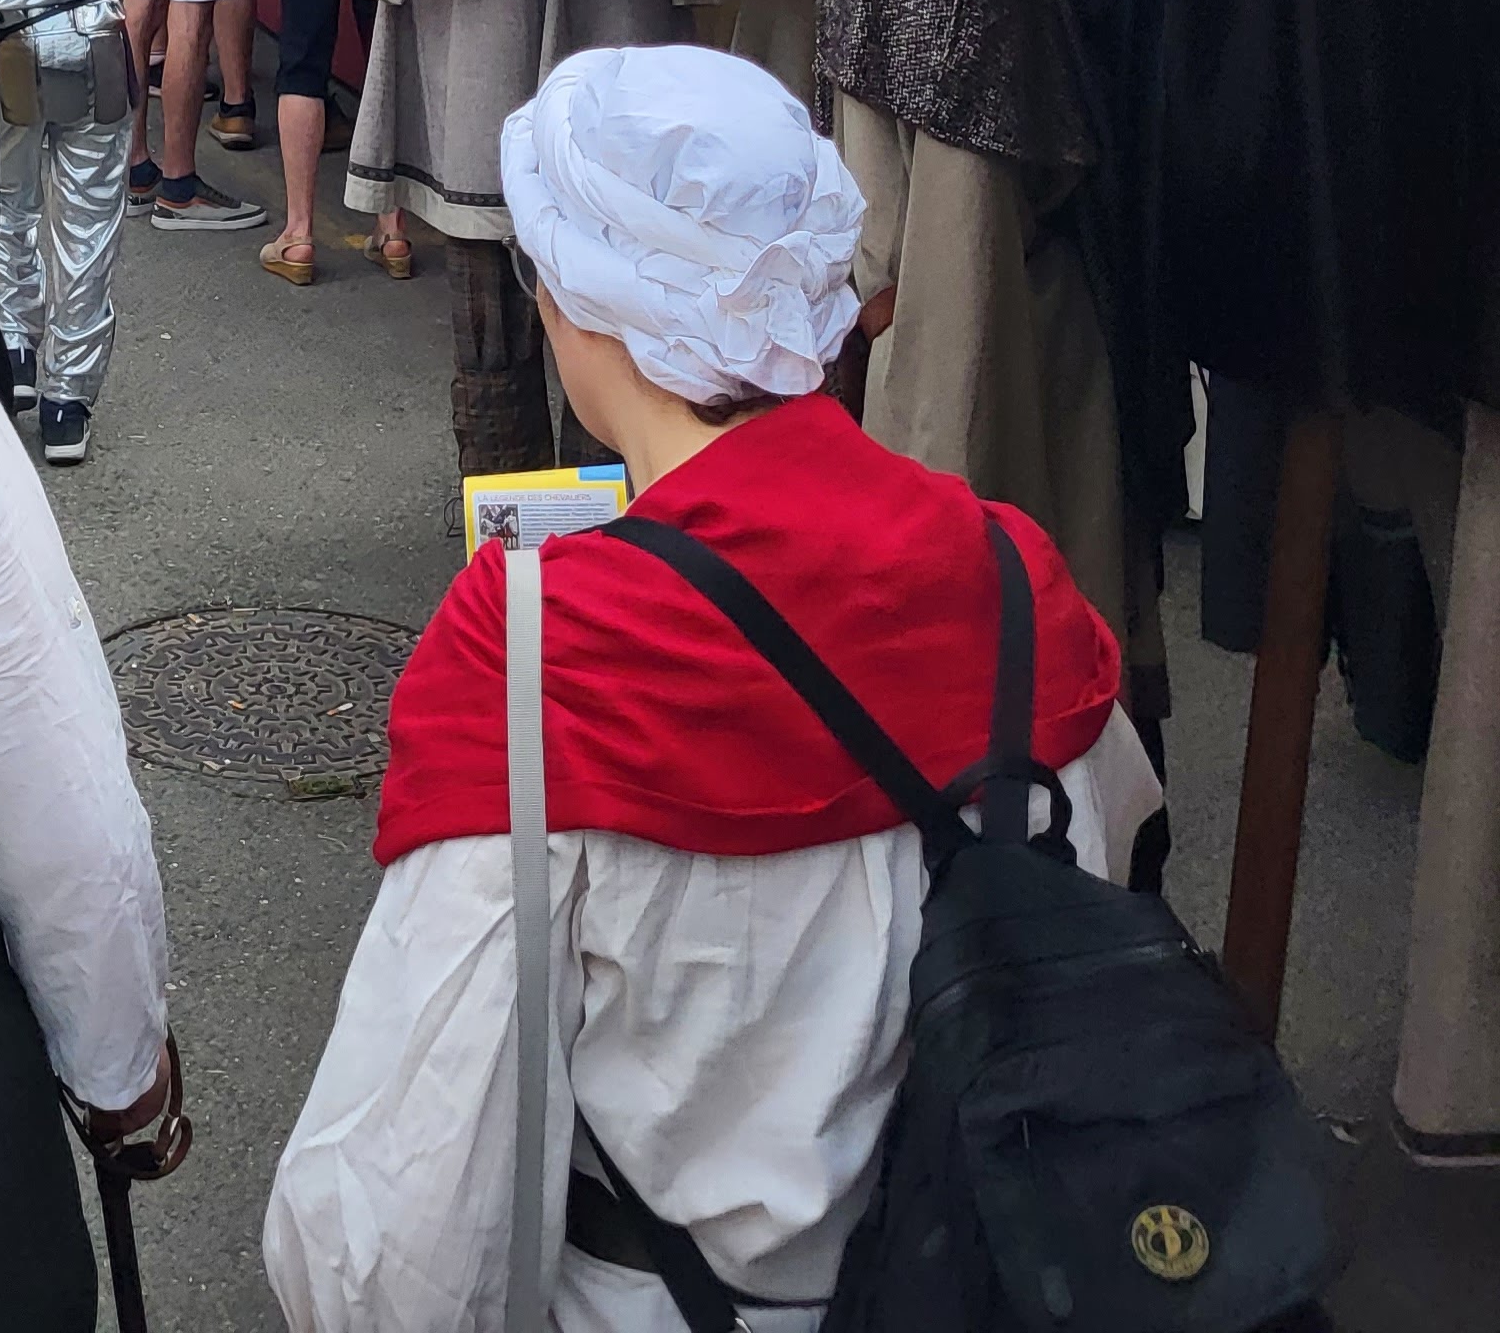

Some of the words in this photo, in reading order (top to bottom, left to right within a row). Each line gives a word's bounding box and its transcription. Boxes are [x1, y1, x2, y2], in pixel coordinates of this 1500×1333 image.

[477, 494, 488, 502] LA
[527, 493, 543, 501] DES
[544, 492, 592, 501] CHEVALIERS
